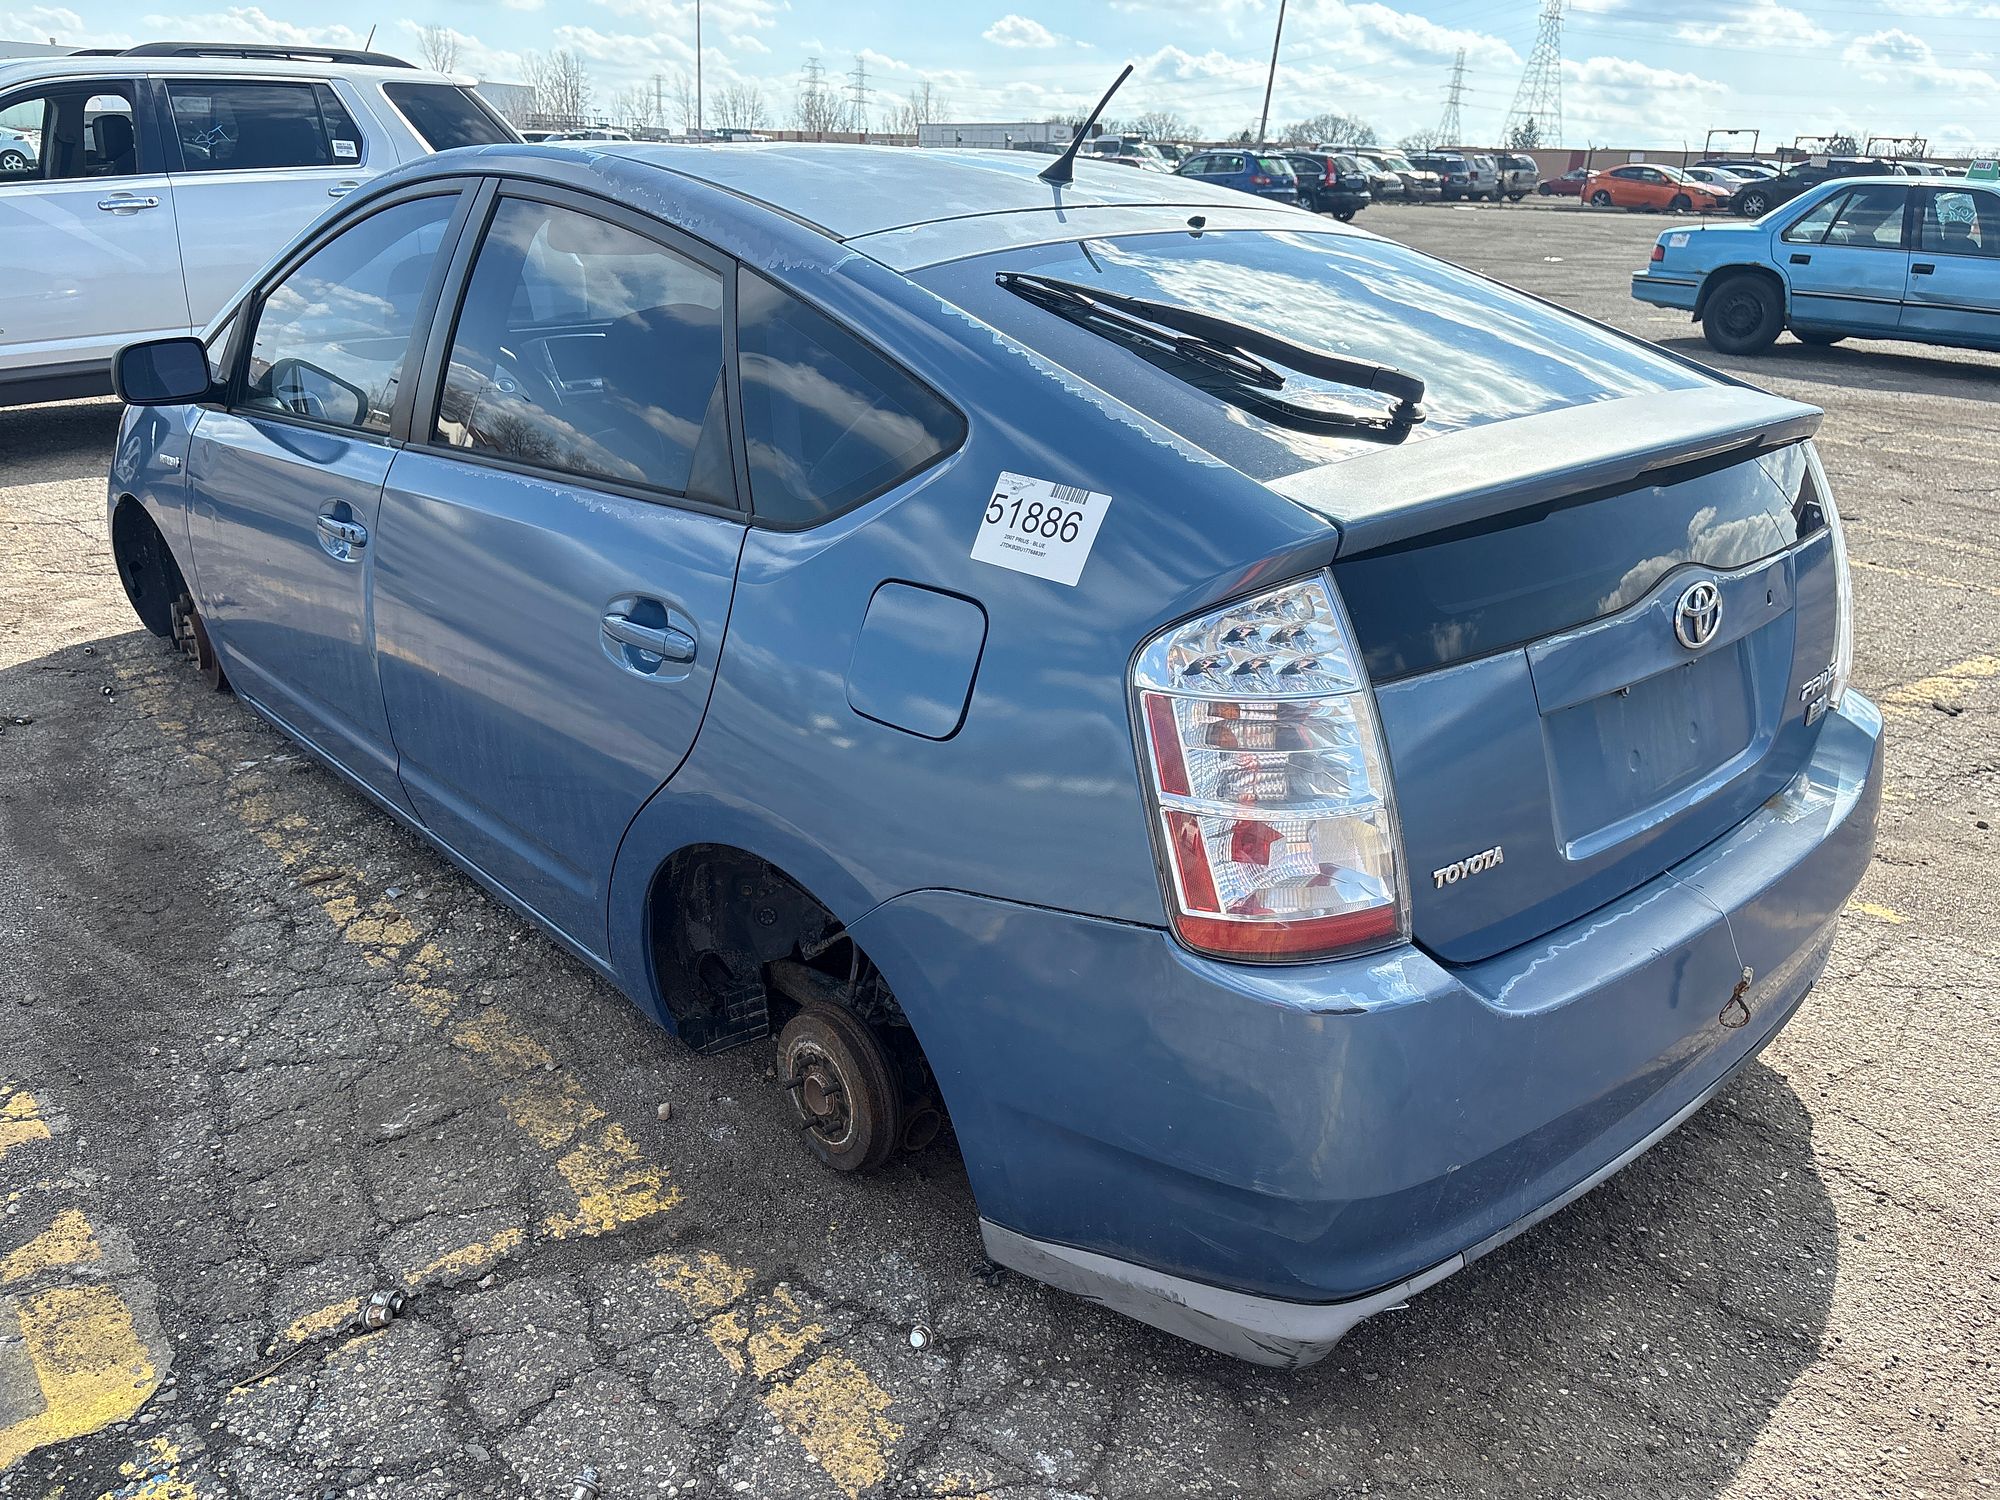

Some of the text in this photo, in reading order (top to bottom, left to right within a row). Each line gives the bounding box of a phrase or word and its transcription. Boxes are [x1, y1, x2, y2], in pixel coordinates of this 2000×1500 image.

[985, 493, 1083, 543] 51886
[1003, 533, 1015, 541] 2007
[1015, 536, 1030, 545] PRIUS
[1032, 540, 1046, 549] BLUE
[1432, 845, 1504, 889] TOYOTA
